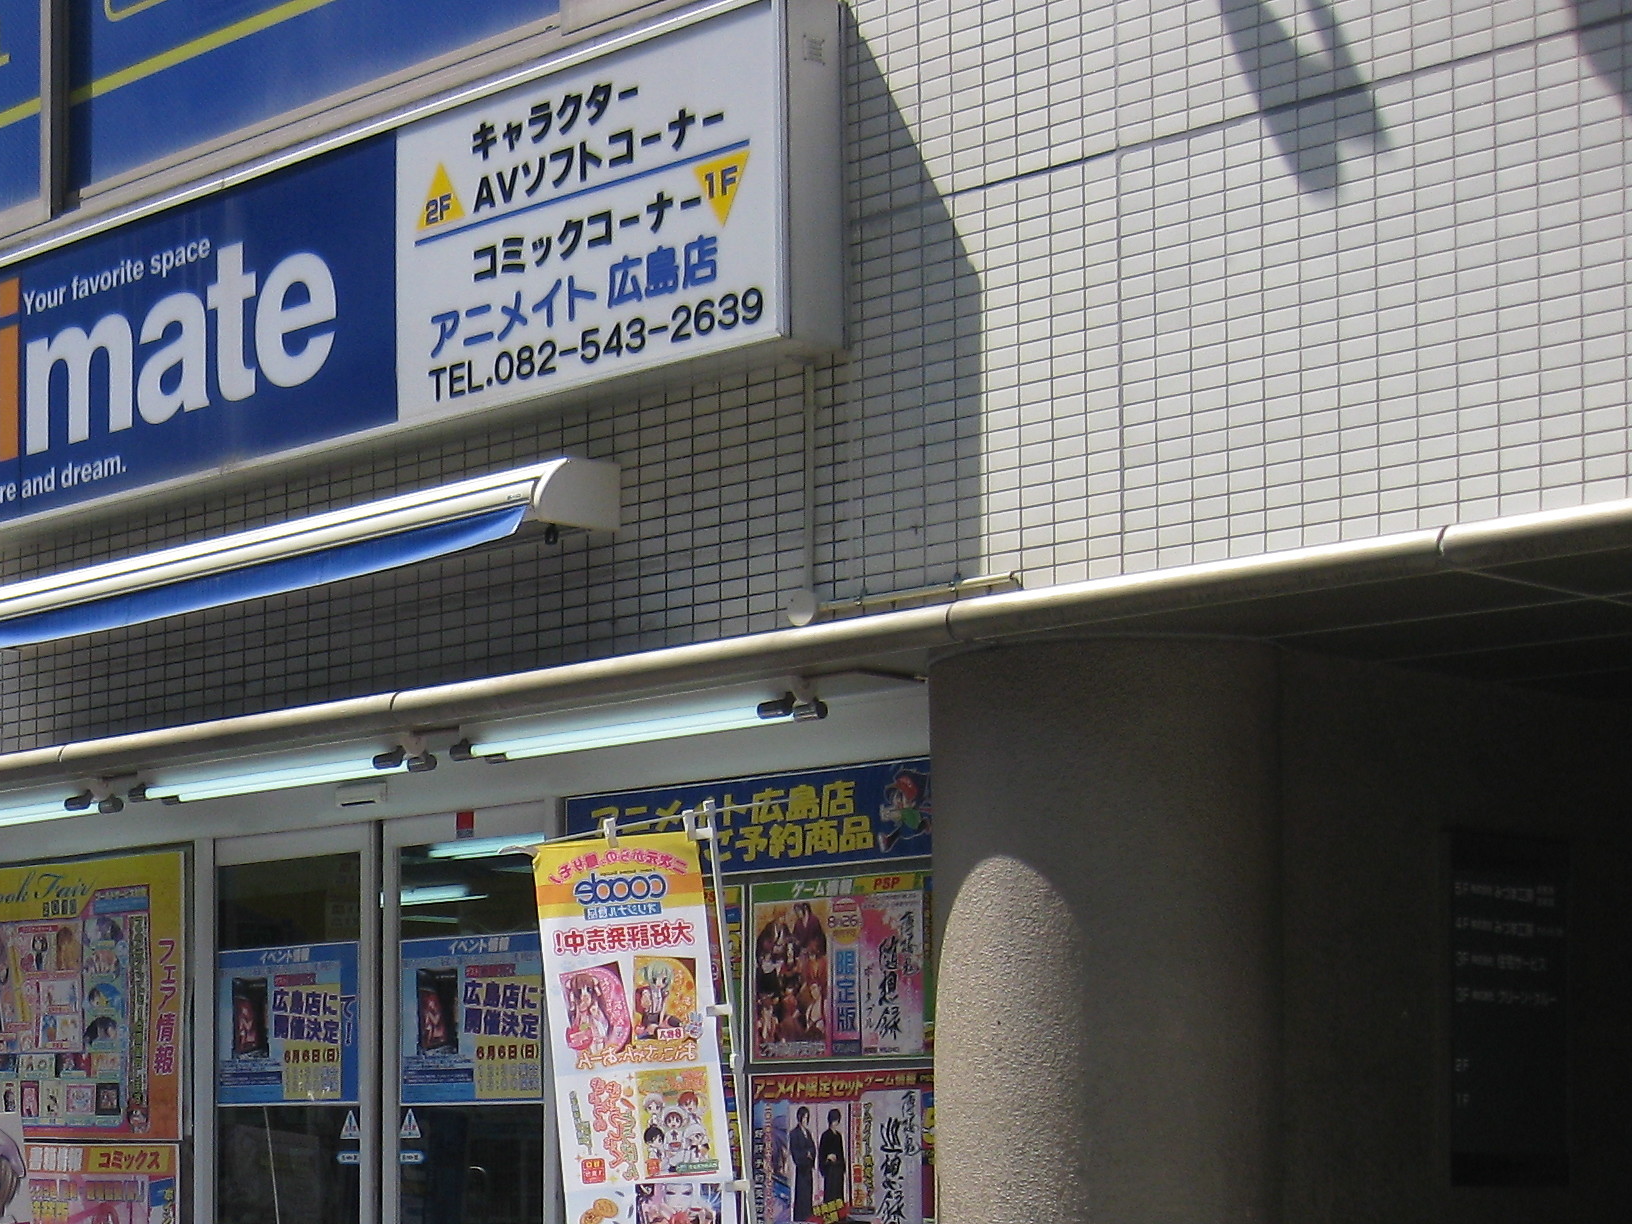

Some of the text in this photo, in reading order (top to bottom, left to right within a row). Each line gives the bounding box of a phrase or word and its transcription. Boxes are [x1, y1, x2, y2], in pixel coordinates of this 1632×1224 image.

[471, 82, 639, 161] キャラクター
[473, 108, 725, 214] AVソフトコーナー
[704, 165, 739, 200] 1F
[425, 192, 451, 226] 2F
[473, 191, 702, 282] コミックコーナー
[23, 238, 211, 316] Your favorite space
[429, 286, 764, 402] TEL.082-543-2639
[21, 471, 56, 498] and
[61, 452, 128, 488] dream.
[874, 877, 901, 890] PSP
[153, 938, 177, 1076] フェア情報
[463, 980, 544, 1010] 広島店に
[835, 949, 857, 1032] 限定版
[98, 1150, 161, 1170] コミックス
